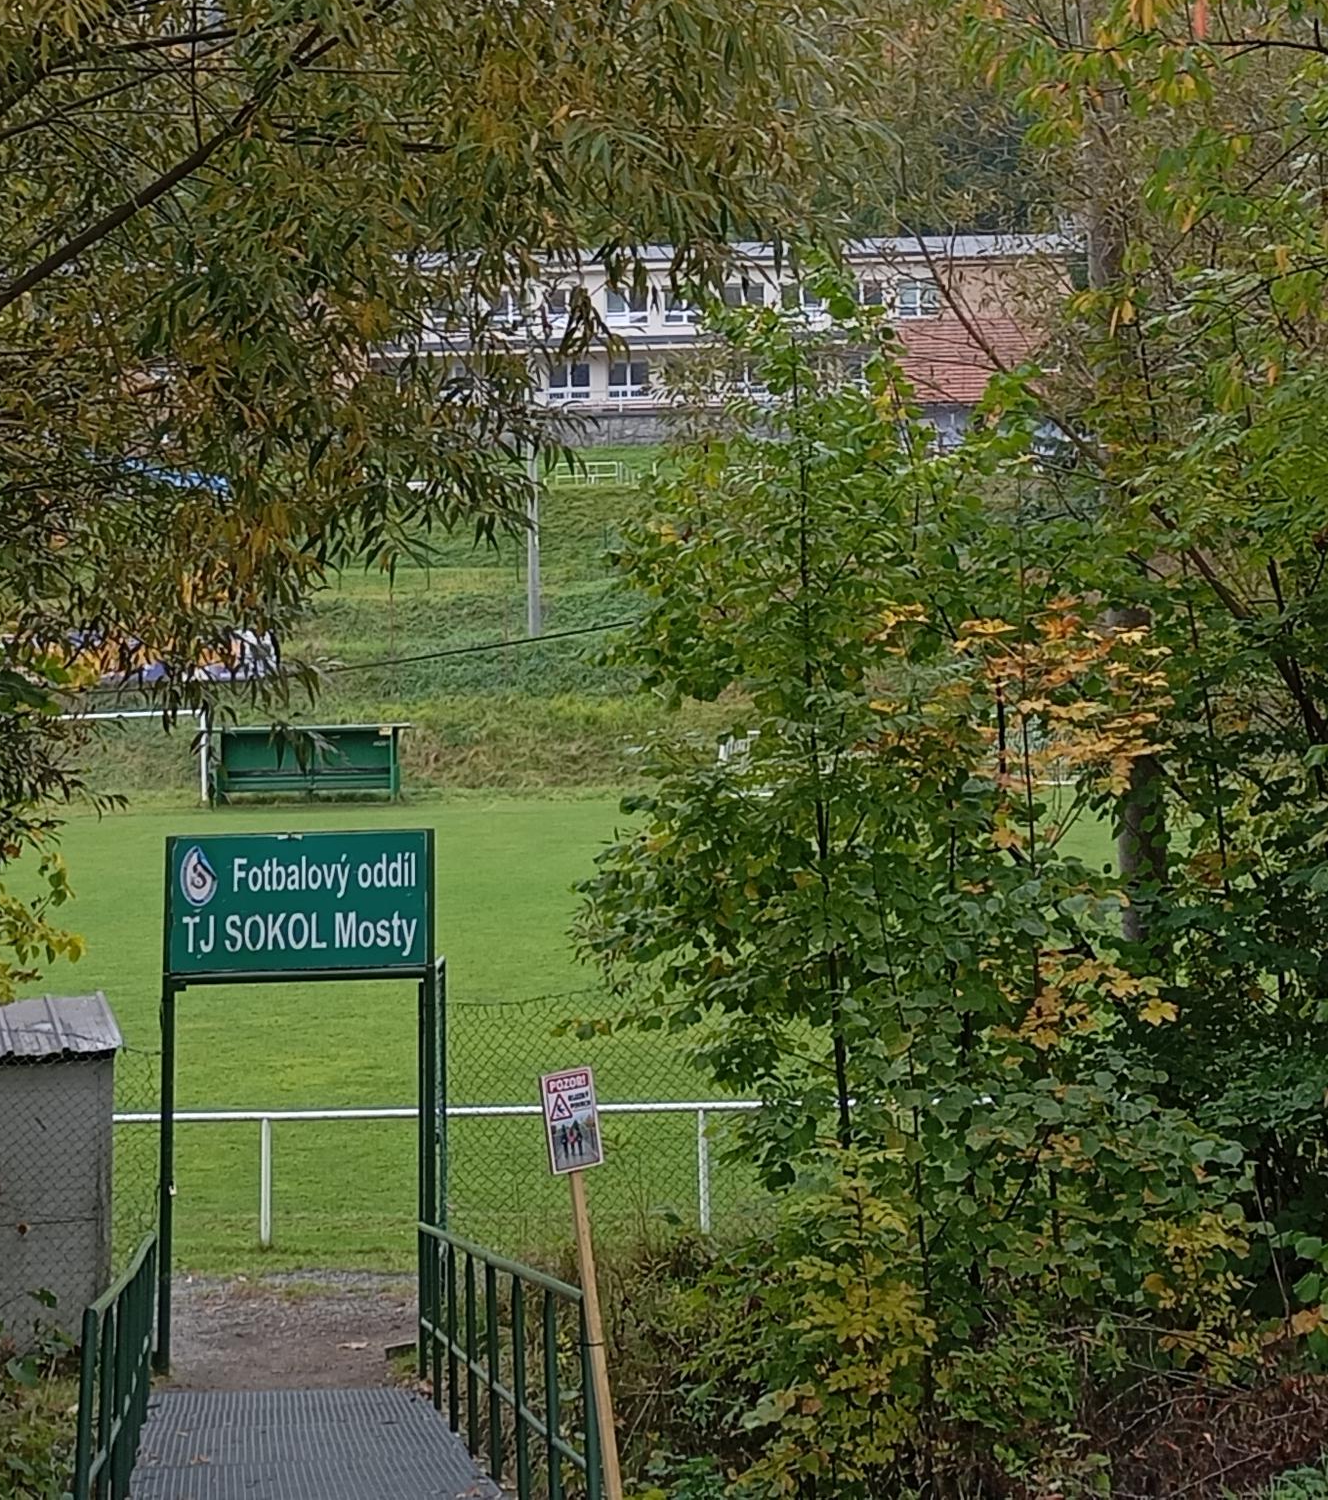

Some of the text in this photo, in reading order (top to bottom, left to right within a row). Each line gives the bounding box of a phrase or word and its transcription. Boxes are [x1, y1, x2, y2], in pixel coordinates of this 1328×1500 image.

[233, 852, 416, 898] Fotbalový oddíl
[182, 911, 417, 956] TJ SOKOL Mosty
